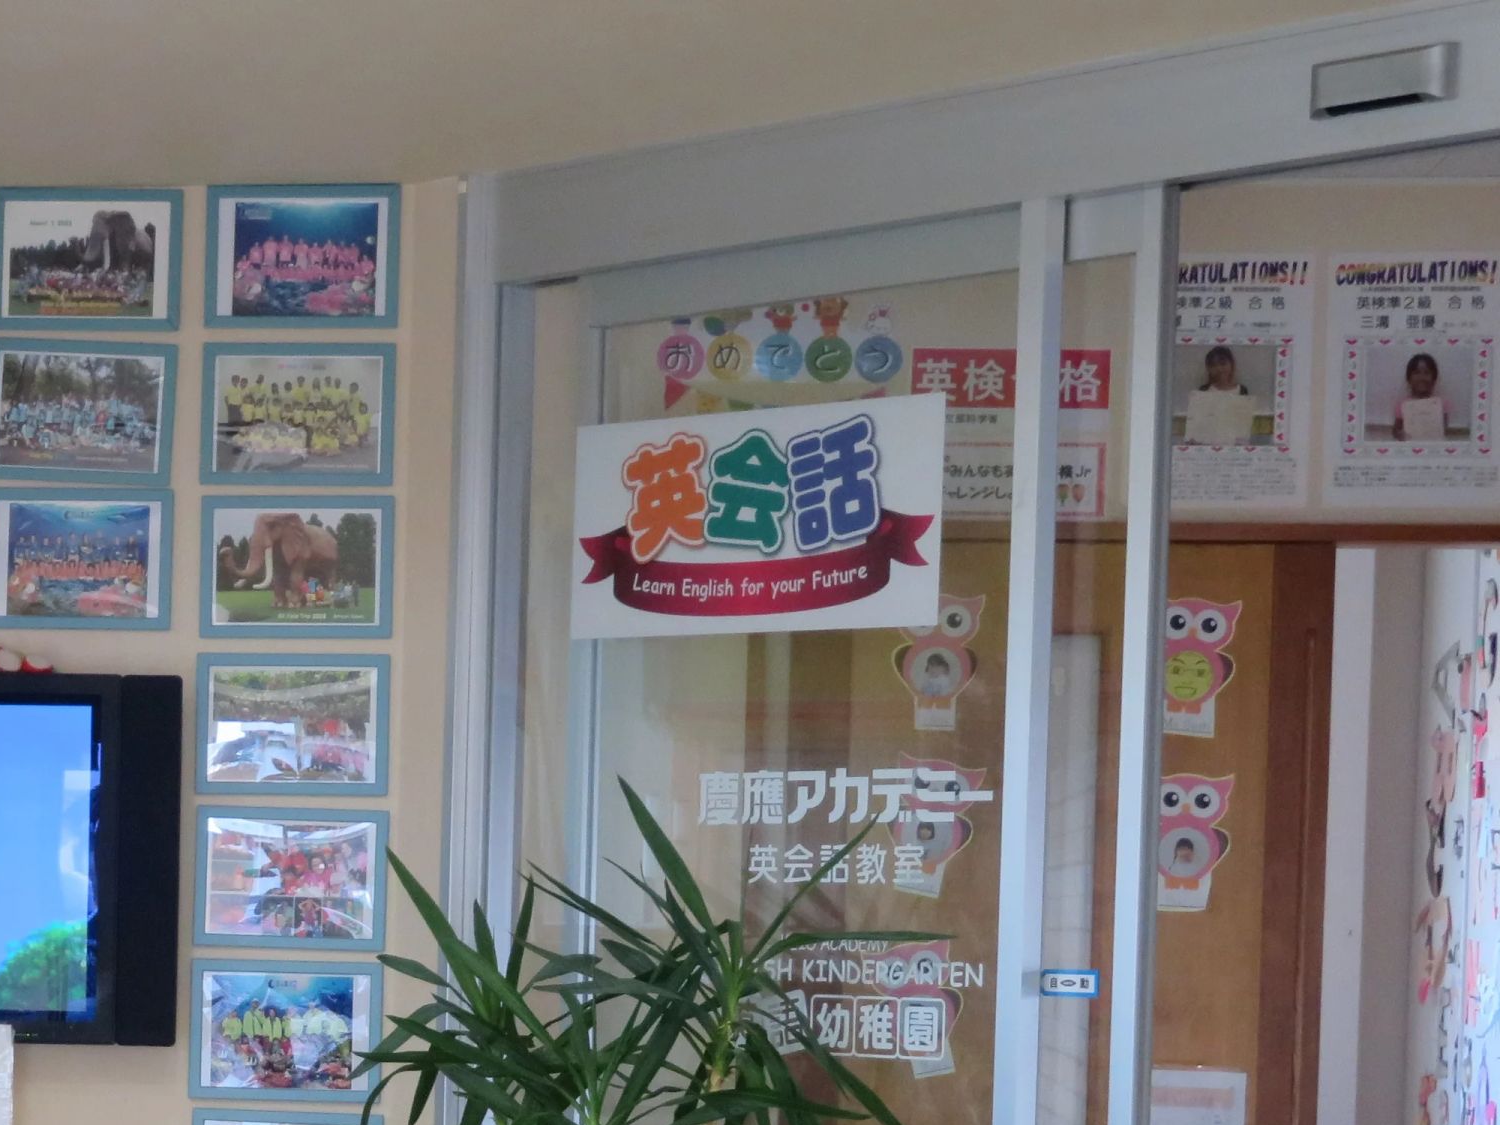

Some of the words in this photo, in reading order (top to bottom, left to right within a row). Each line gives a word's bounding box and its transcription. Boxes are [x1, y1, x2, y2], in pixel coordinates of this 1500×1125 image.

[1178, 261, 1308, 286] RATULATIONS!!
[916, 356, 1103, 402] 英検格
[621, 414, 881, 564] 英会話
[632, 573, 676, 597] Learn
[681, 578, 734, 602] English
[740, 577, 765, 597] for
[771, 577, 806, 600] your
[811, 565, 869, 590] Future
[698, 767, 994, 827] 慶應アカデミー
[747, 843, 925, 885] 英会話教室
[802, 959, 984, 989] KINDERGARTEN
